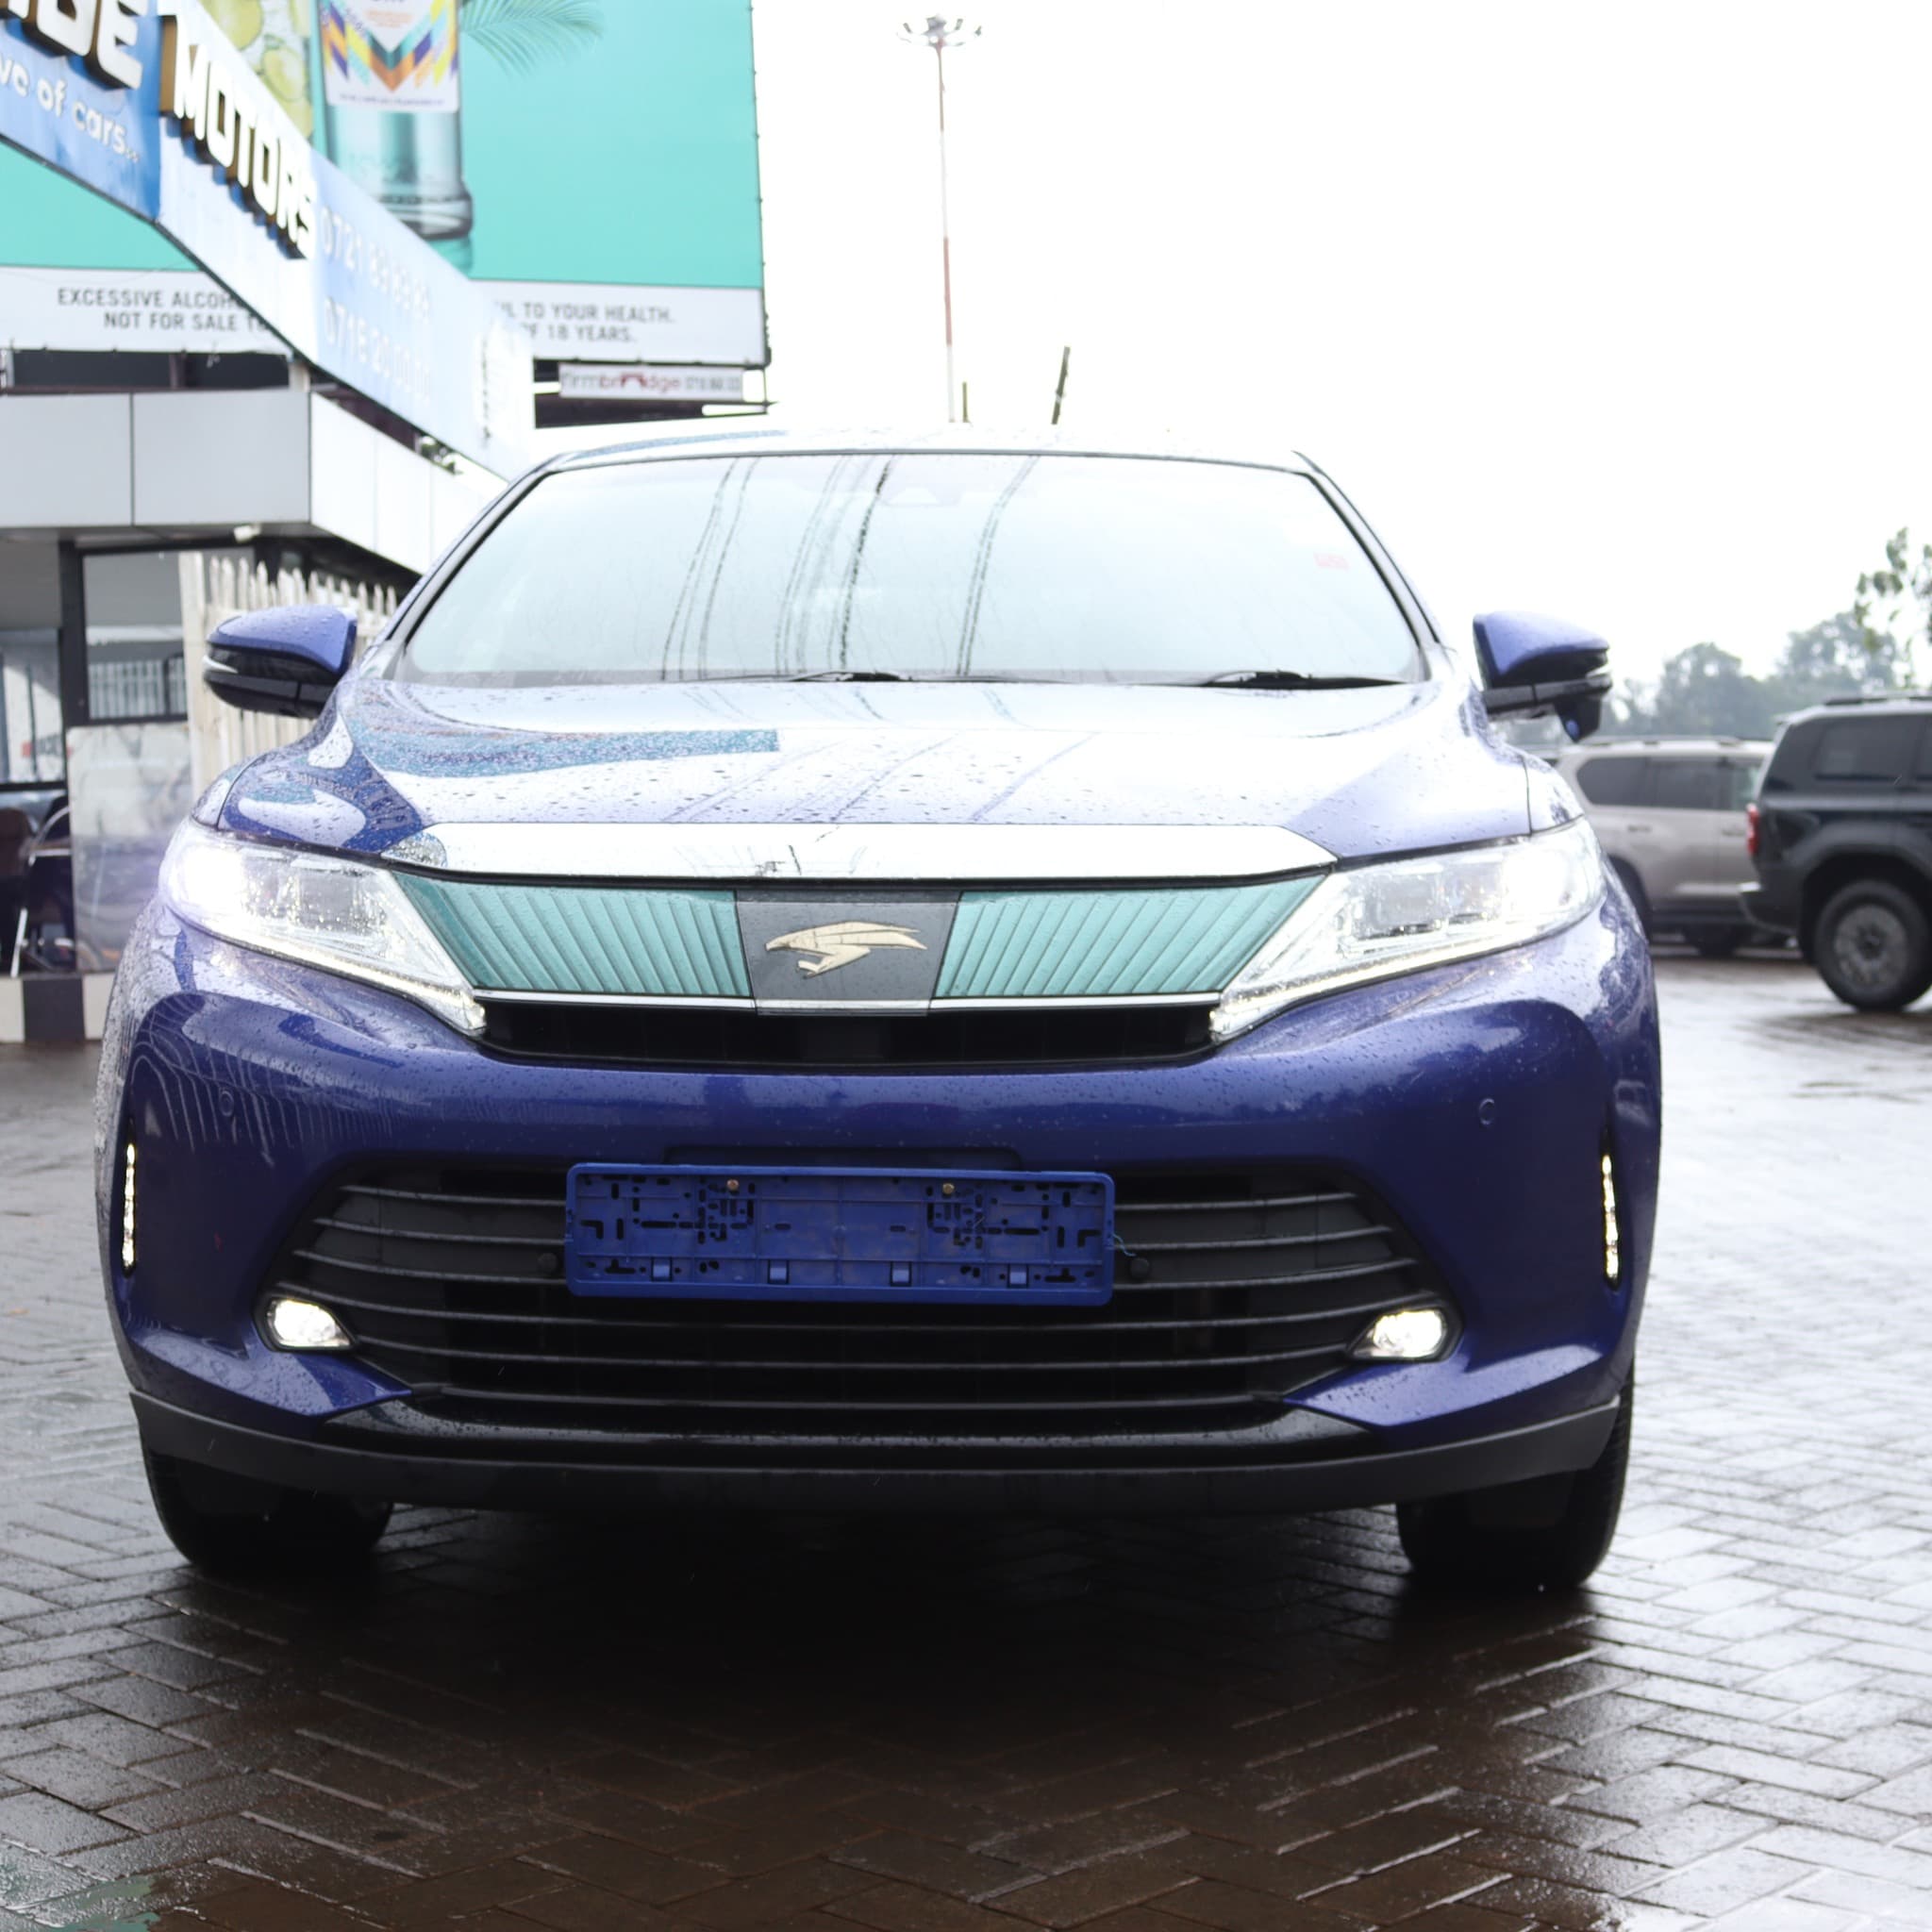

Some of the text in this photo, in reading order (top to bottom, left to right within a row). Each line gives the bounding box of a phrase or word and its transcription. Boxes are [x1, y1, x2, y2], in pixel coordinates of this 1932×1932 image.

[38, 77, 67, 118] of
[174, 11, 318, 260] MOTORS
[58, 288, 164, 308] EXCESSIVE
[172, 291, 242, 309] ALCOH
[524, 300, 544, 319] TO
[550, 301, 598, 321] YOUR
[605, 303, 675, 324] HEALTH.
[104, 311, 142, 330] NOT
[149, 313, 185, 331] FOR
[192, 313, 238, 332] SALE
[547, 323, 570, 341] 18
[575, 324, 637, 343] YEARS.
